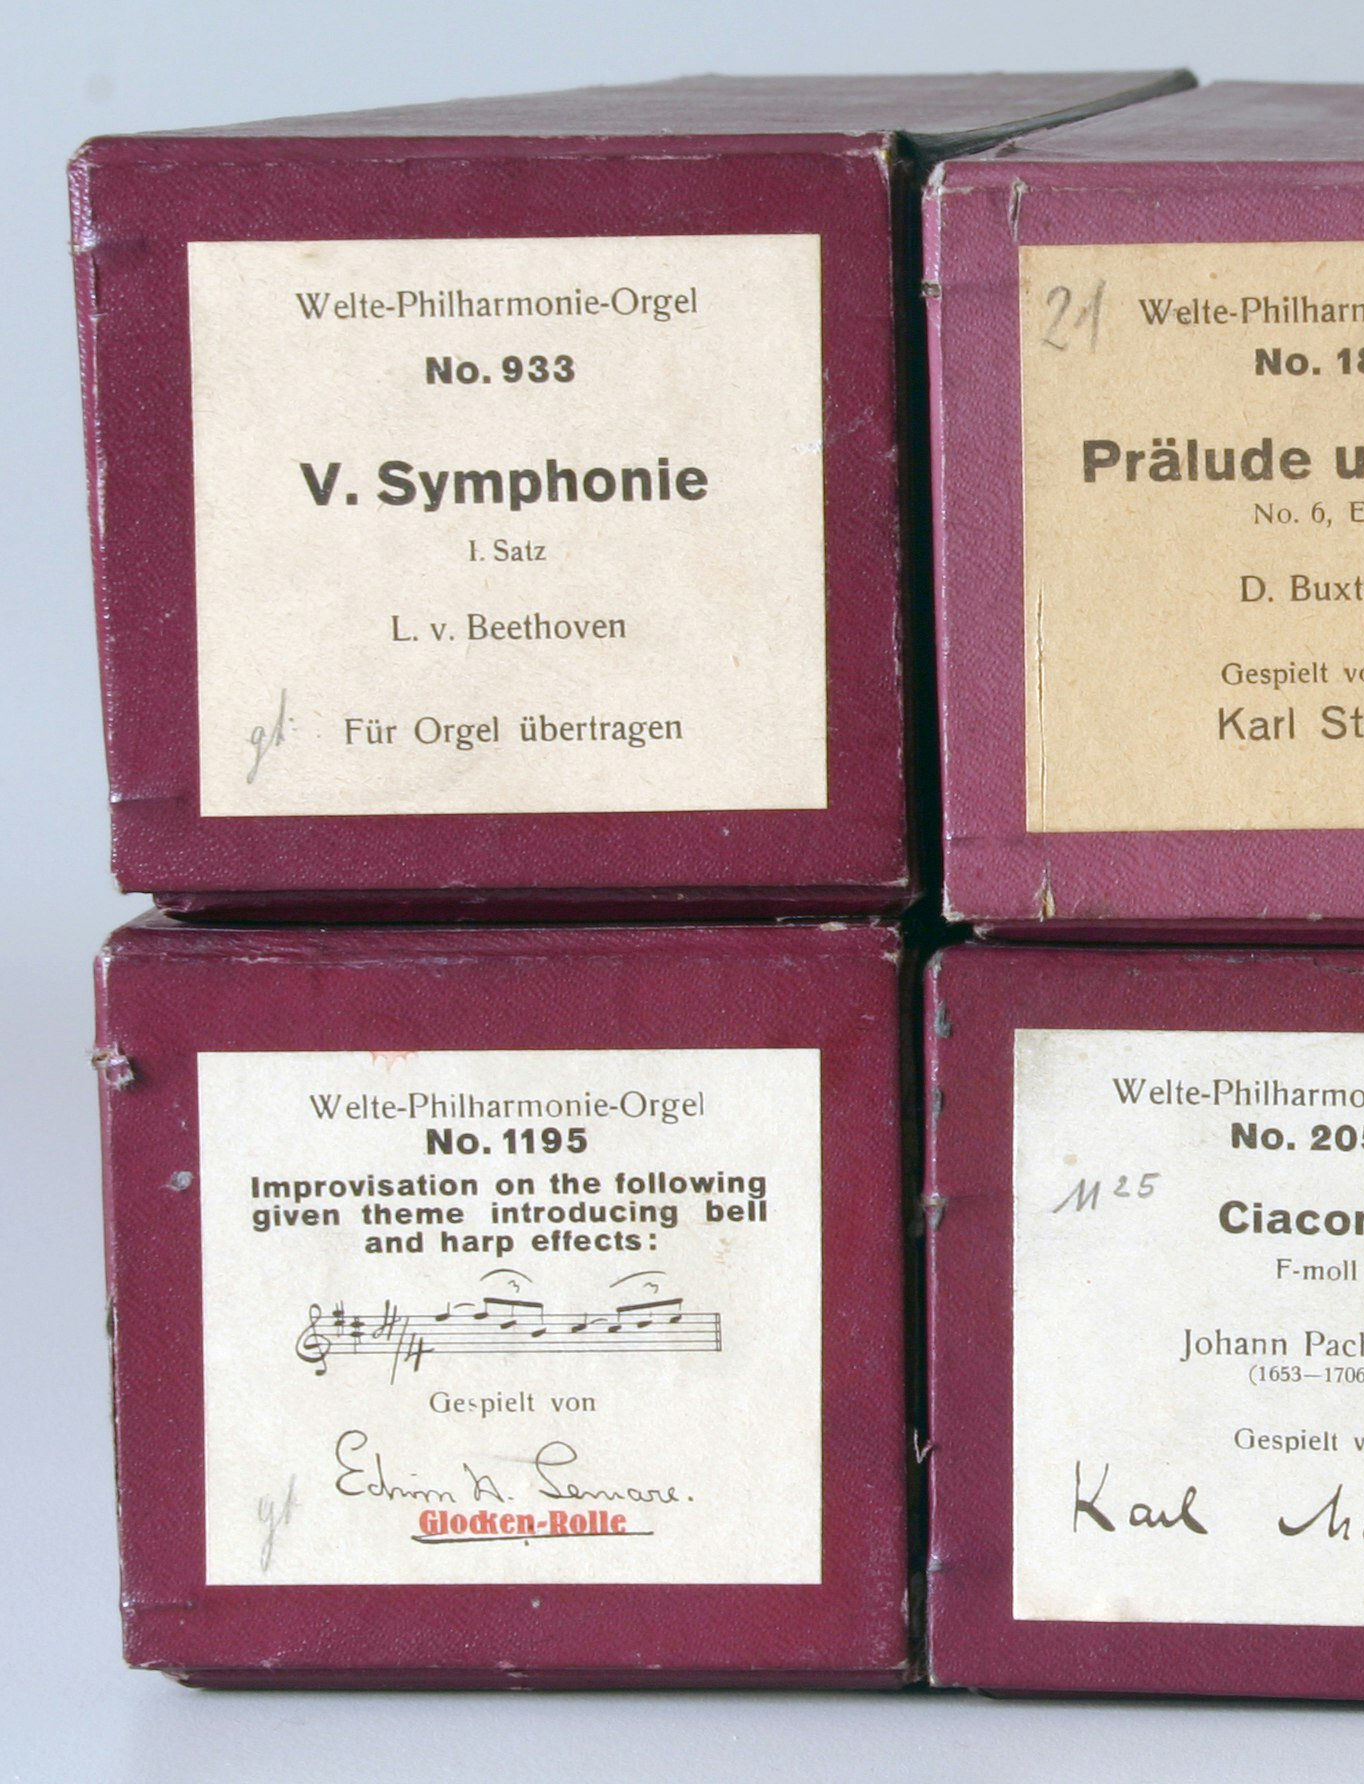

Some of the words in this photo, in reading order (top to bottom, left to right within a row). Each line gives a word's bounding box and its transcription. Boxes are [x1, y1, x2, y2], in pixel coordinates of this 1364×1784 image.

[296, 287, 697, 322] Welte-Philharmonie-Orgel
[426, 357, 491, 384] No.
[502, 355, 574, 383] 933
[1256, 348, 1320, 376] No.
[1083, 438, 1311, 482] Prälude
[300, 463, 357, 505] V.
[377, 457, 708, 512] Symphonie
[1255, 503, 1298, 524] No.
[1312, 502, 1331, 527] 6,
[494, 539, 546, 561] Satz
[1240, 576, 1273, 602] D.
[392, 616, 418, 641] L.
[430, 623, 454, 641] v.
[468, 613, 625, 640] Beethoven
[1221, 662, 1328, 690] Gespielt
[345, 719, 397, 744] Für
[415, 716, 498, 751] Orgel
[520, 715, 682, 748] übertragen
[1219, 707, 1294, 741] Karl
[310, 1091, 703, 1124] Welte-Philharmonie-Orgel
[427, 1129, 490, 1155] No.
[503, 1127, 587, 1154] 1195
[1232, 1123, 1295, 1150] No.
[252, 1174, 477, 1203] Improvisation
[496, 1178, 534, 1195] on
[550, 1173, 601, 1194] the
[615, 1171, 766, 1199] following
[253, 1205, 339, 1232] given
[362, 1204, 464, 1224] theme
[492, 1201, 678, 1228] introducing
[706, 1200, 766, 1222] bell
[365, 1232, 423, 1253] and
[441, 1231, 513, 1257] harp
[1277, 1259, 1356, 1281] F-moll
[1180, 1329, 1286, 1362] Johann
[430, 1392, 534, 1418] Gespielt
[551, 1397, 595, 1412] von
[1234, 1428, 1337, 1453] Gespielt
[1073, 1459, 1209, 1536] Karl
[417, 1509, 628, 1536] Glocken-Rolle
